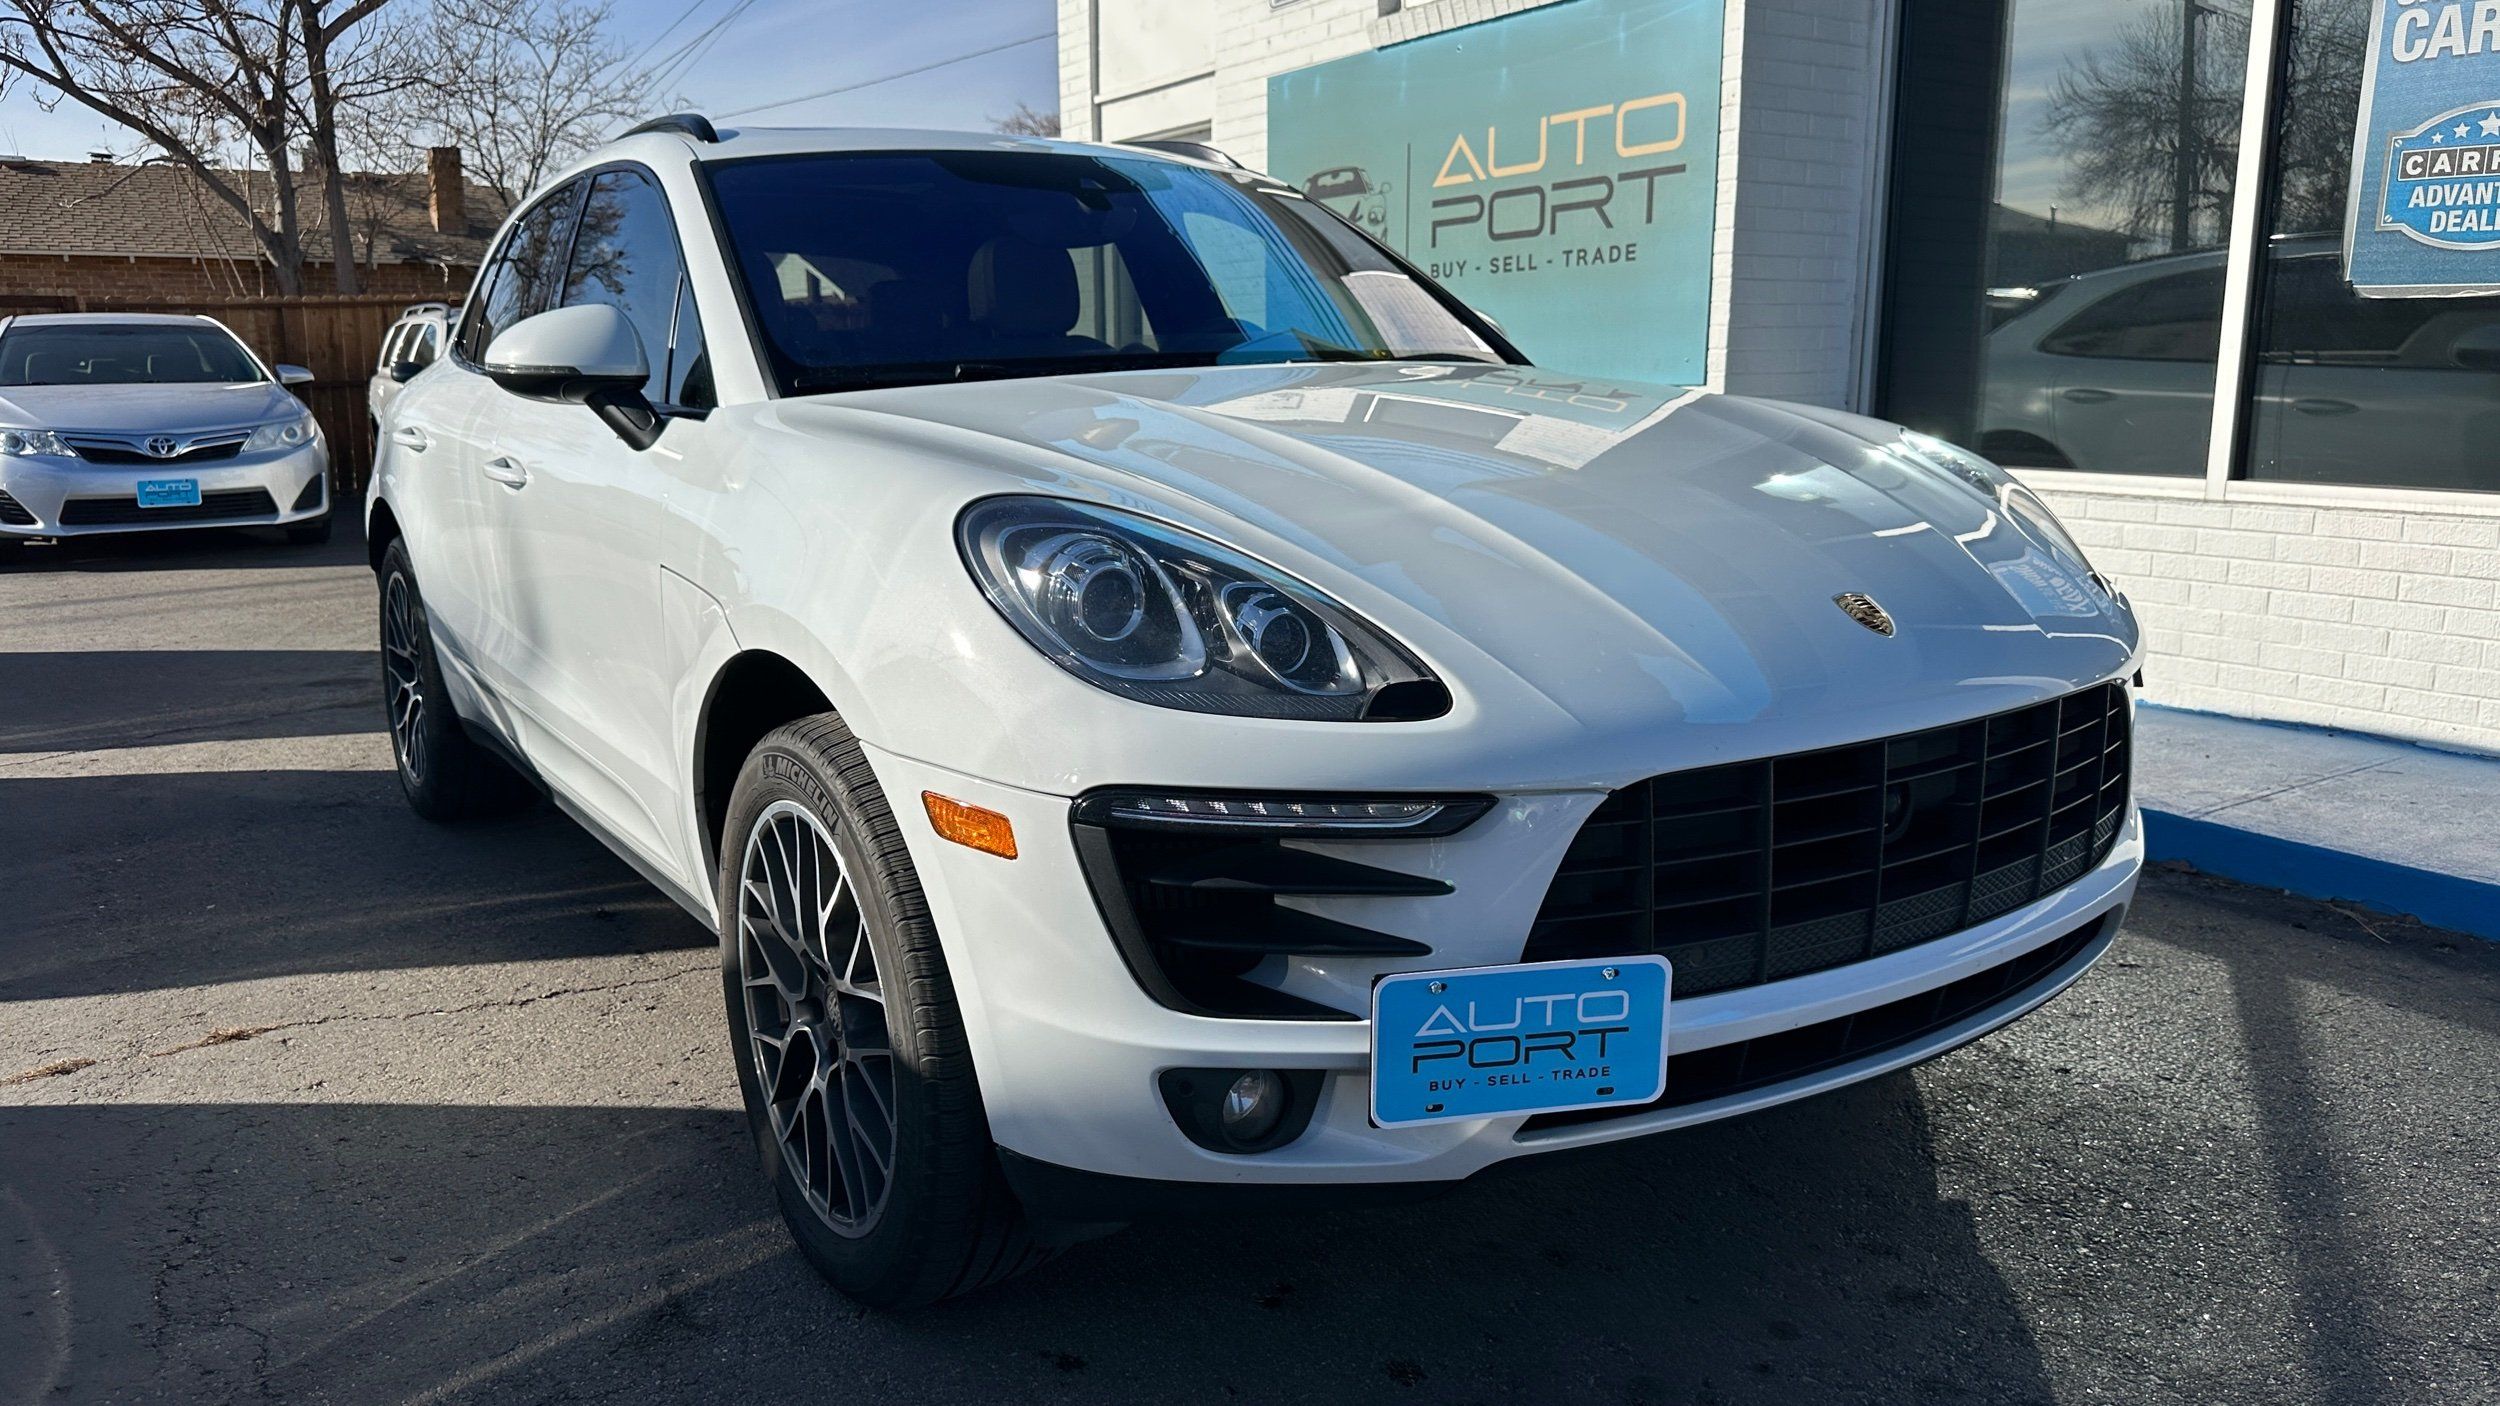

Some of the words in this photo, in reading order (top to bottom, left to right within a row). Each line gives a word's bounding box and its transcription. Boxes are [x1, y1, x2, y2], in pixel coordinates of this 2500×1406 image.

[1432, 91, 1687, 188] AUTO
[1431, 164, 1686, 248] PORT
[1430, 260, 1467, 279] BUY
[1489, 253, 1538, 274] SELL
[1562, 243, 1638, 268] TRADE
[145, 483, 191, 491] AUTO
[775, 756, 839, 828] MICHELIN
[1414, 989, 1629, 1037] AUTO
[1412, 1026, 1629, 1074] PORT
[1429, 1078, 1466, 1092] BUY
[1487, 1072, 1531, 1087] SELL
[1551, 1066, 1611, 1081] TRADE
